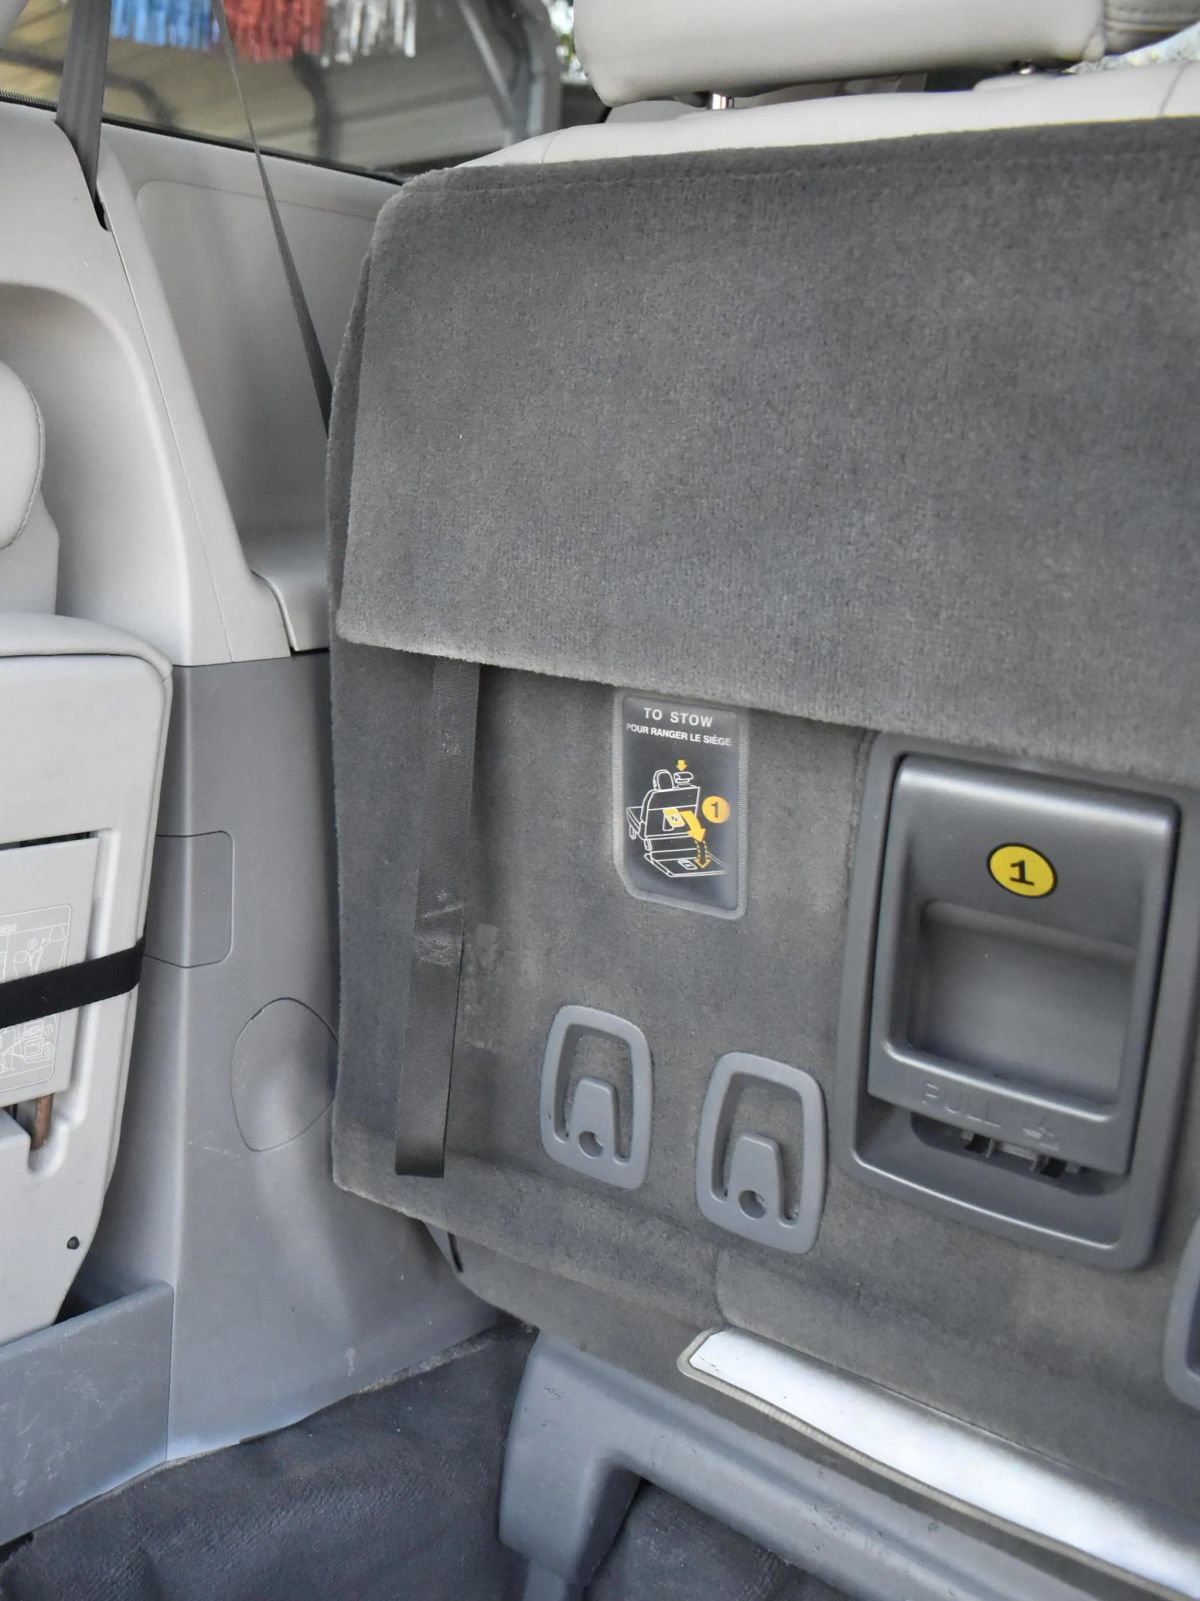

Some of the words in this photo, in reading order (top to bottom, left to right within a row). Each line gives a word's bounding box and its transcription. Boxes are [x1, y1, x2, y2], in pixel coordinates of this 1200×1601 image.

[643, 707, 663, 721] TO
[670, 711, 713, 728] STOW
[626, 723, 649, 735] POUR
[651, 727, 688, 740] RANGER
[689, 733, 702, 743] LE
[710, 801, 719, 818] 1
[1010, 860, 1035, 886] 1
[921, 1080, 1001, 1128] PULL
